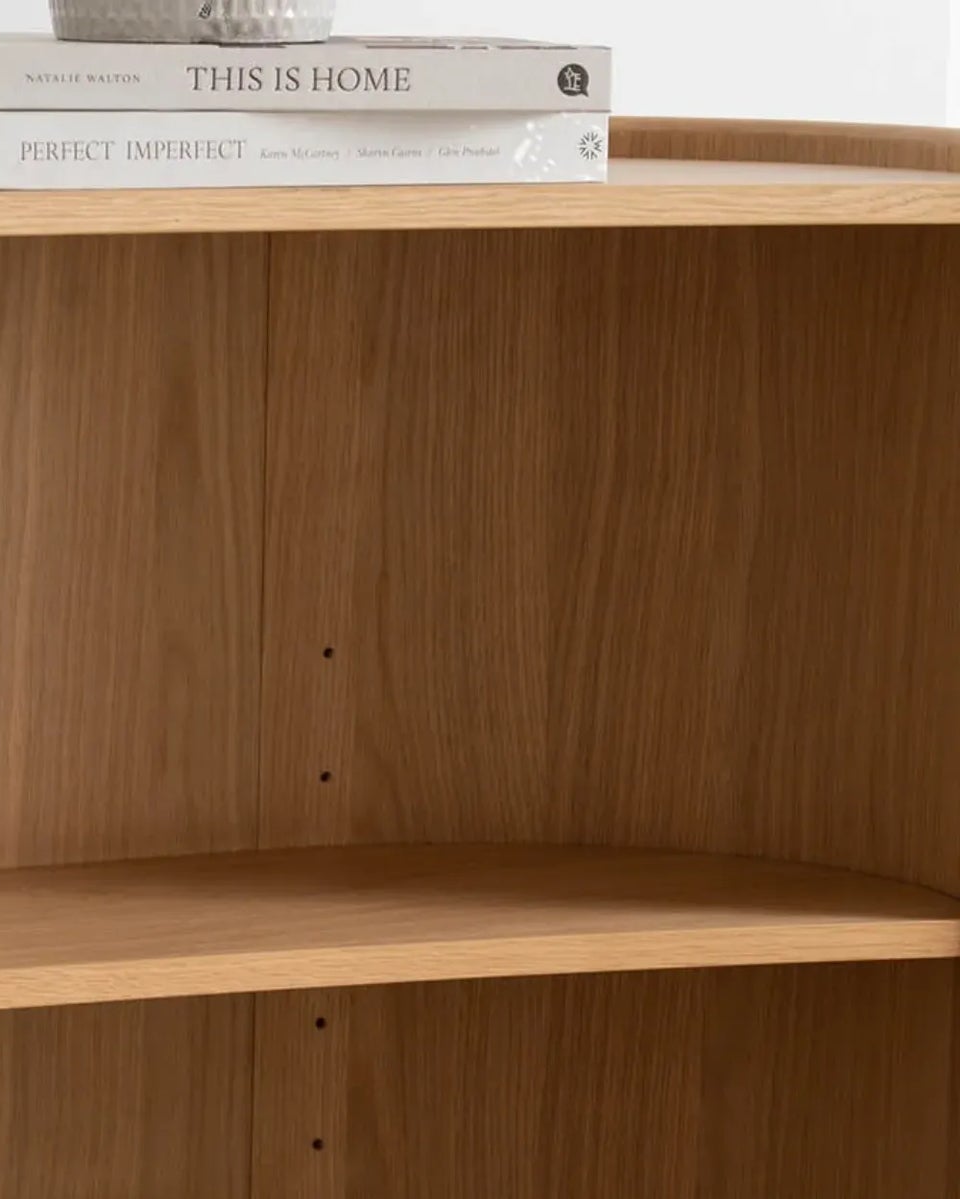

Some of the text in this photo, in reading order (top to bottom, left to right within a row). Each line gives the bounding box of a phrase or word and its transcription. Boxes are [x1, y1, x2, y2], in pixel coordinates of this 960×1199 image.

[24, 72, 141, 84] NATALIE WALTON
[186, 66, 411, 92] THIS IS HOME
[20, 138, 248, 162] PERFECT IMPERFECT
